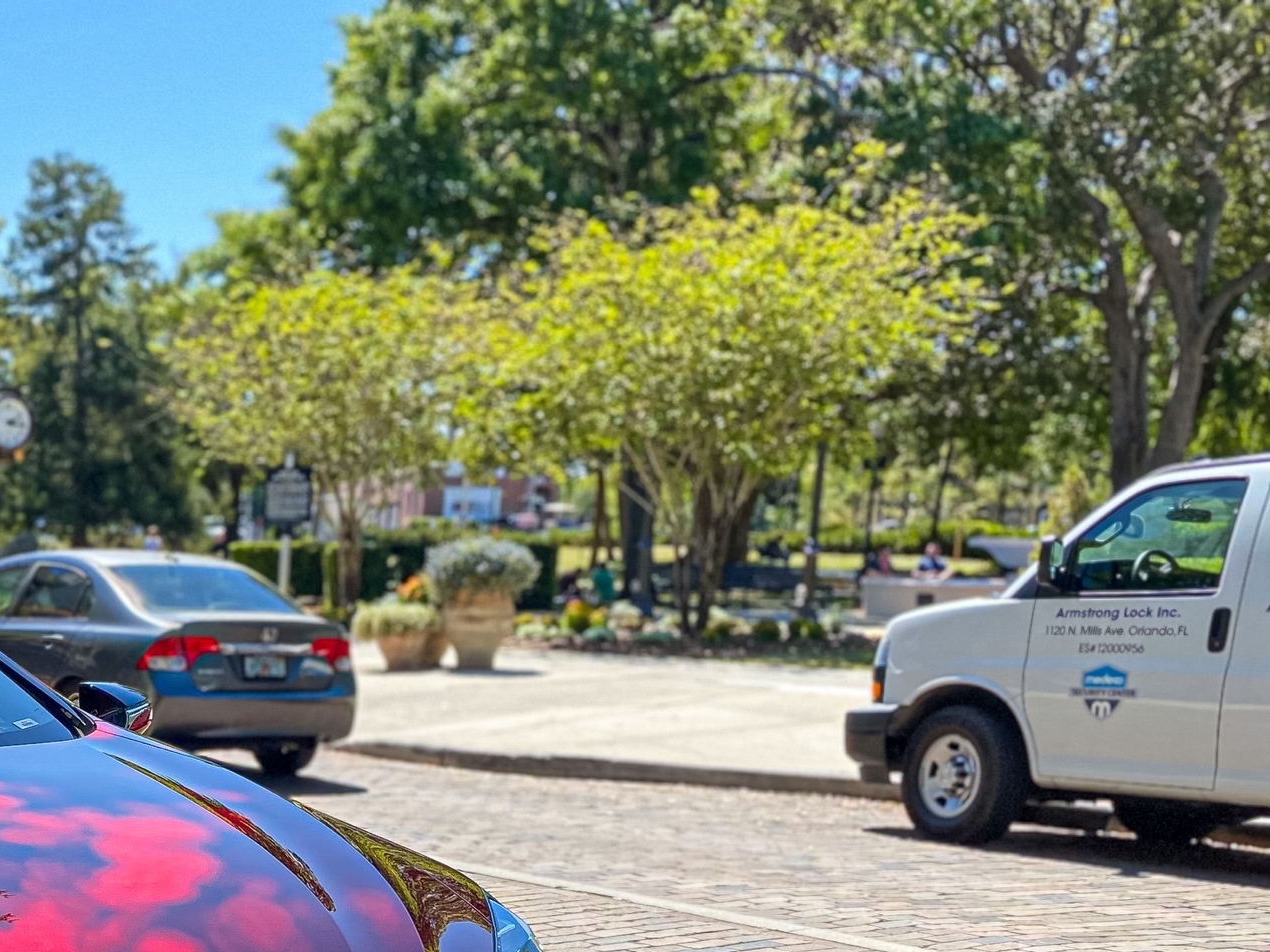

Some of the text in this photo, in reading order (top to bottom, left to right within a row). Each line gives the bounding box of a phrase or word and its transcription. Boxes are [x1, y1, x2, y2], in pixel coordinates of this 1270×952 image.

[1056, 606, 1181, 621] Armstrong Lock Inc.
[1045, 625, 1065, 636] 1120
[1080, 625, 1102, 636] Mills
[1177, 625, 1189, 636] FL
